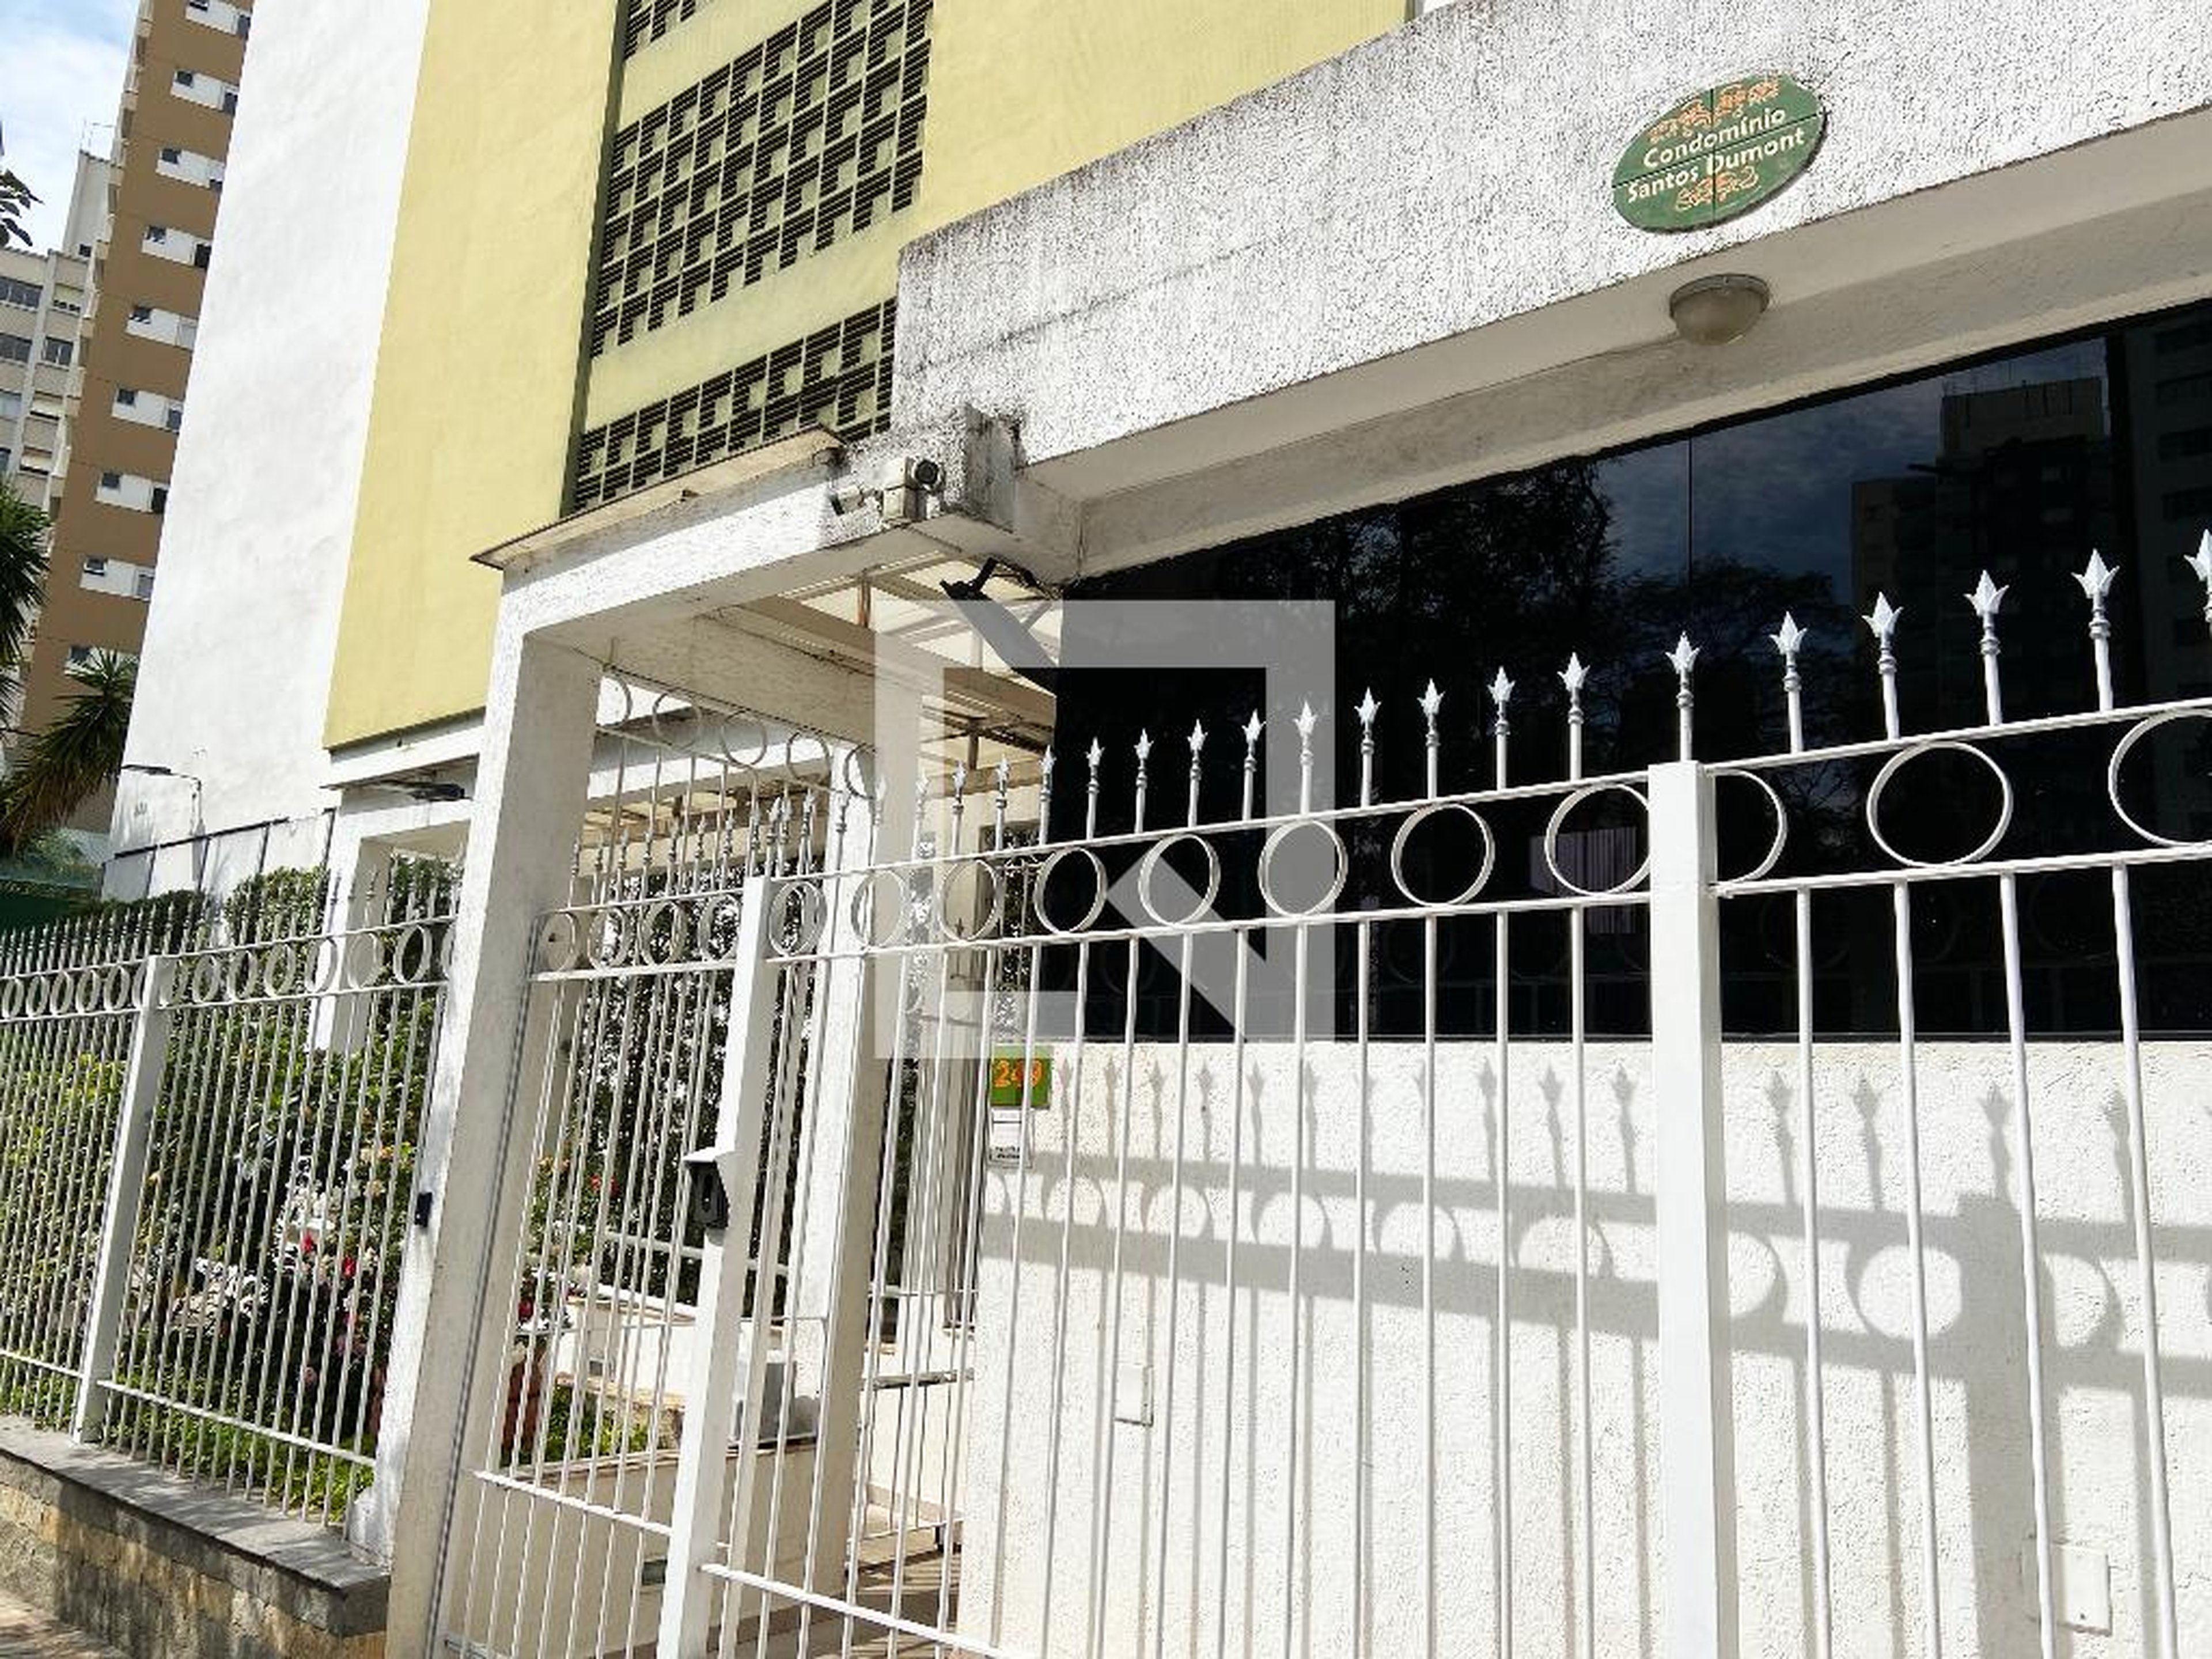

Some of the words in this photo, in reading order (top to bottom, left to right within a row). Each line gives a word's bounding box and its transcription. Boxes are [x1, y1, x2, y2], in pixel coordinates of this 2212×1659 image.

[1627, 165, 1699, 203] Santos
[1706, 127, 1806, 175] Dumont
[1643, 108, 1786, 168] Condomínio
